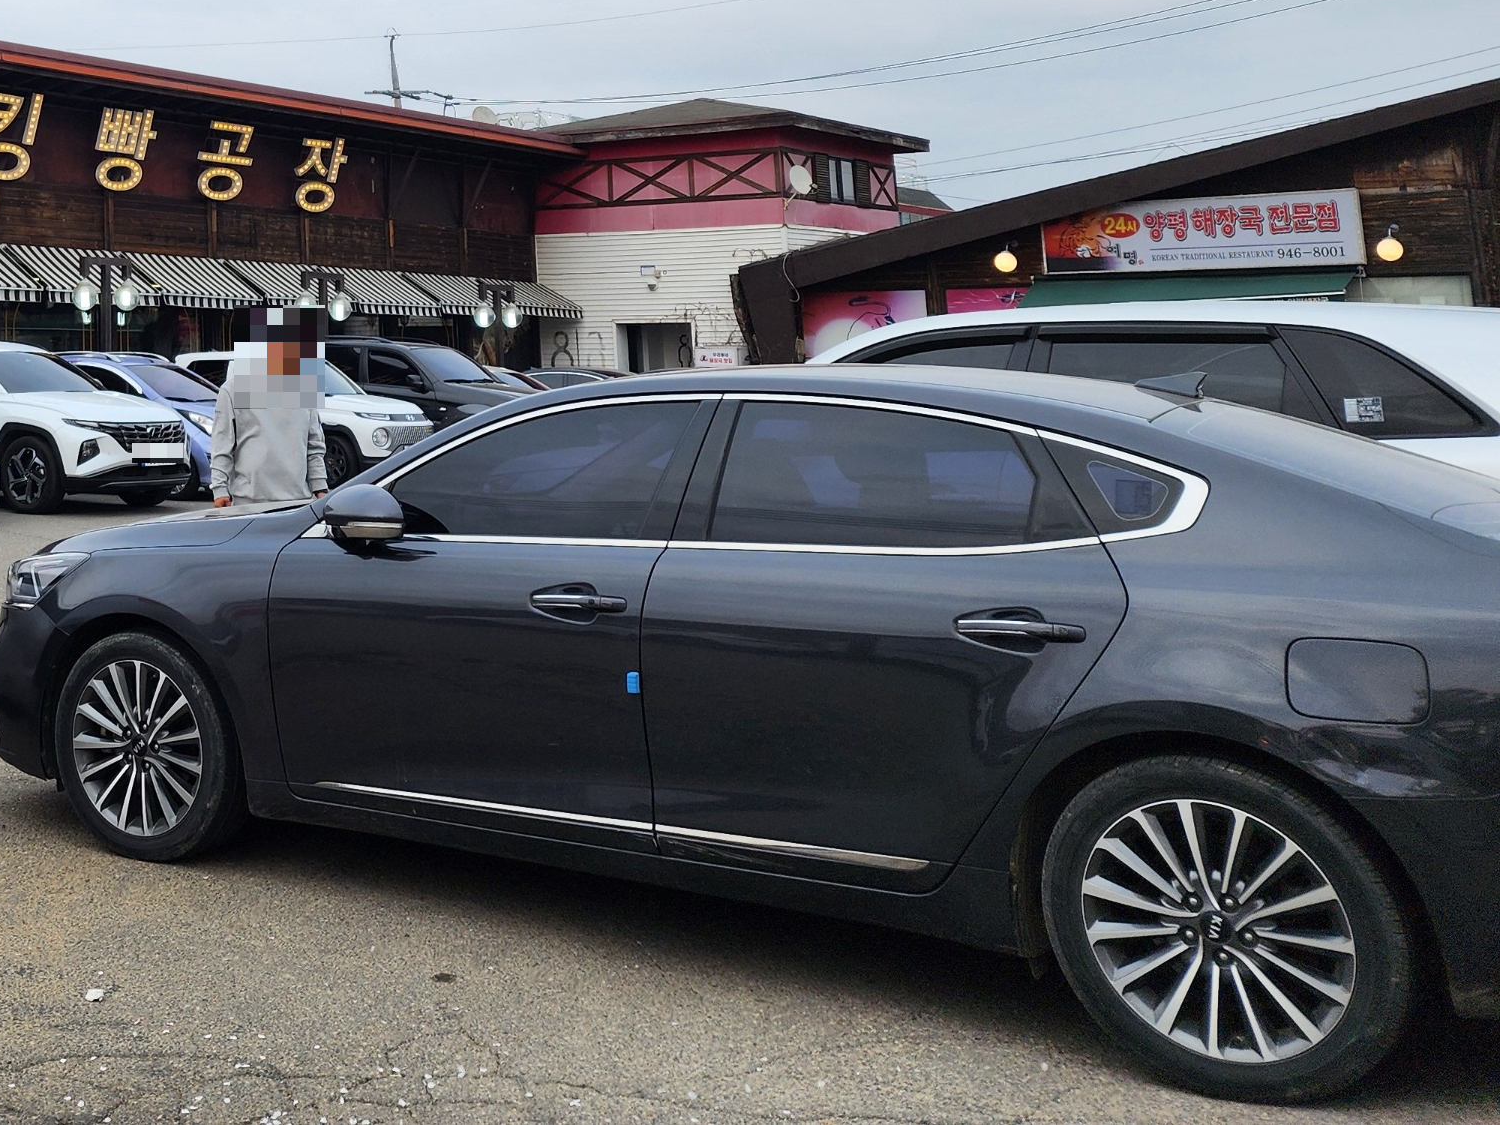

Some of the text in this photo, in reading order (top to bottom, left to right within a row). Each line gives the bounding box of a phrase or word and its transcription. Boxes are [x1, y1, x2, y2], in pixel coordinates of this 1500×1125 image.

[1104, 199, 1341, 242] 24시 양평 해장국 전문점
[1151, 245, 1346, 262] KOREAN TRADITIONAL RESTAURANT 946-8001
